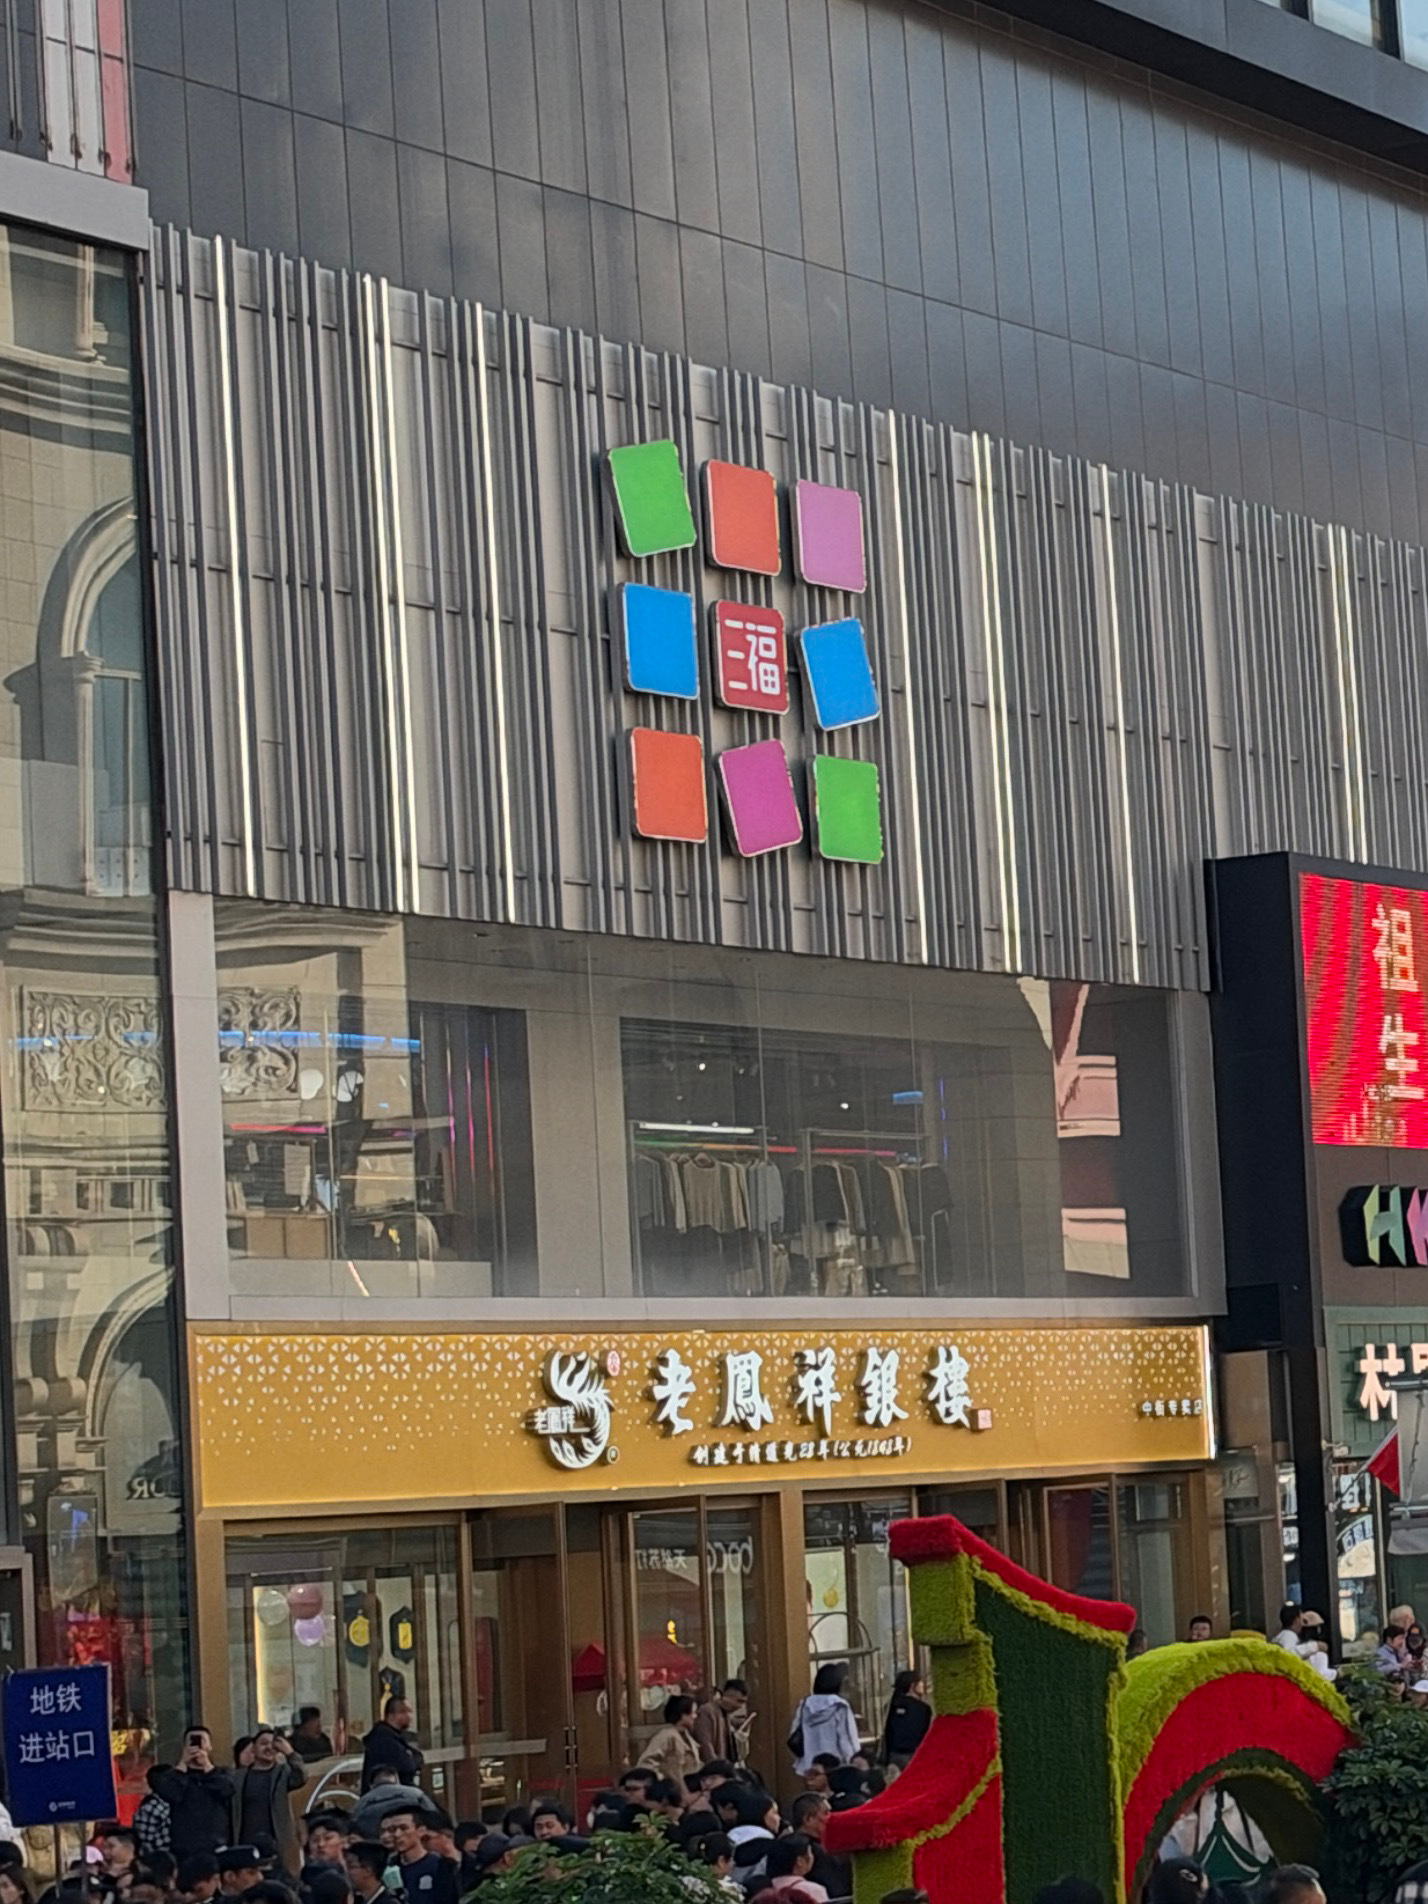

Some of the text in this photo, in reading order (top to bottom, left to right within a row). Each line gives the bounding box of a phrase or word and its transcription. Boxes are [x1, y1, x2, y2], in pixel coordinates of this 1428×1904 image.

[30, 1681, 82, 1716] 地铁
[19, 1729, 97, 1764] 进站口
